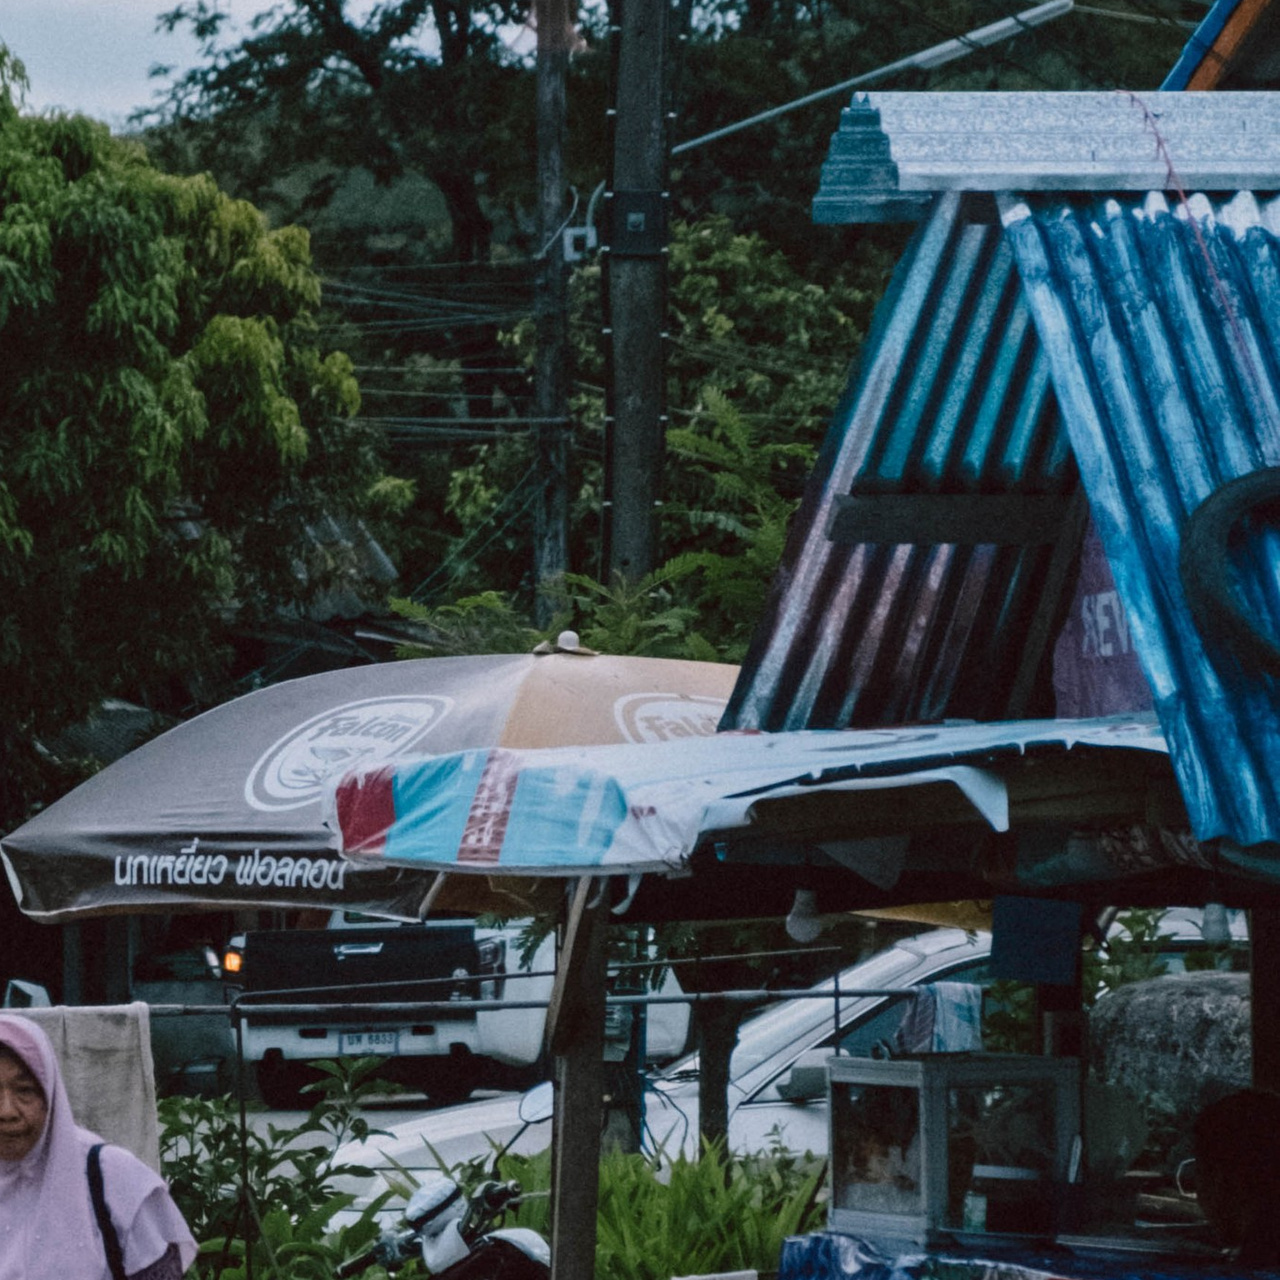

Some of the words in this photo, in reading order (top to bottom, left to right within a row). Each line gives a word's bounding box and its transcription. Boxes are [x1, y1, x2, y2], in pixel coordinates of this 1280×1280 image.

[308, 715, 413, 744] Falcon
[114, 837, 228, 886] นกเหยี่ยว
[235, 848, 348, 890] ฟอลคอน
